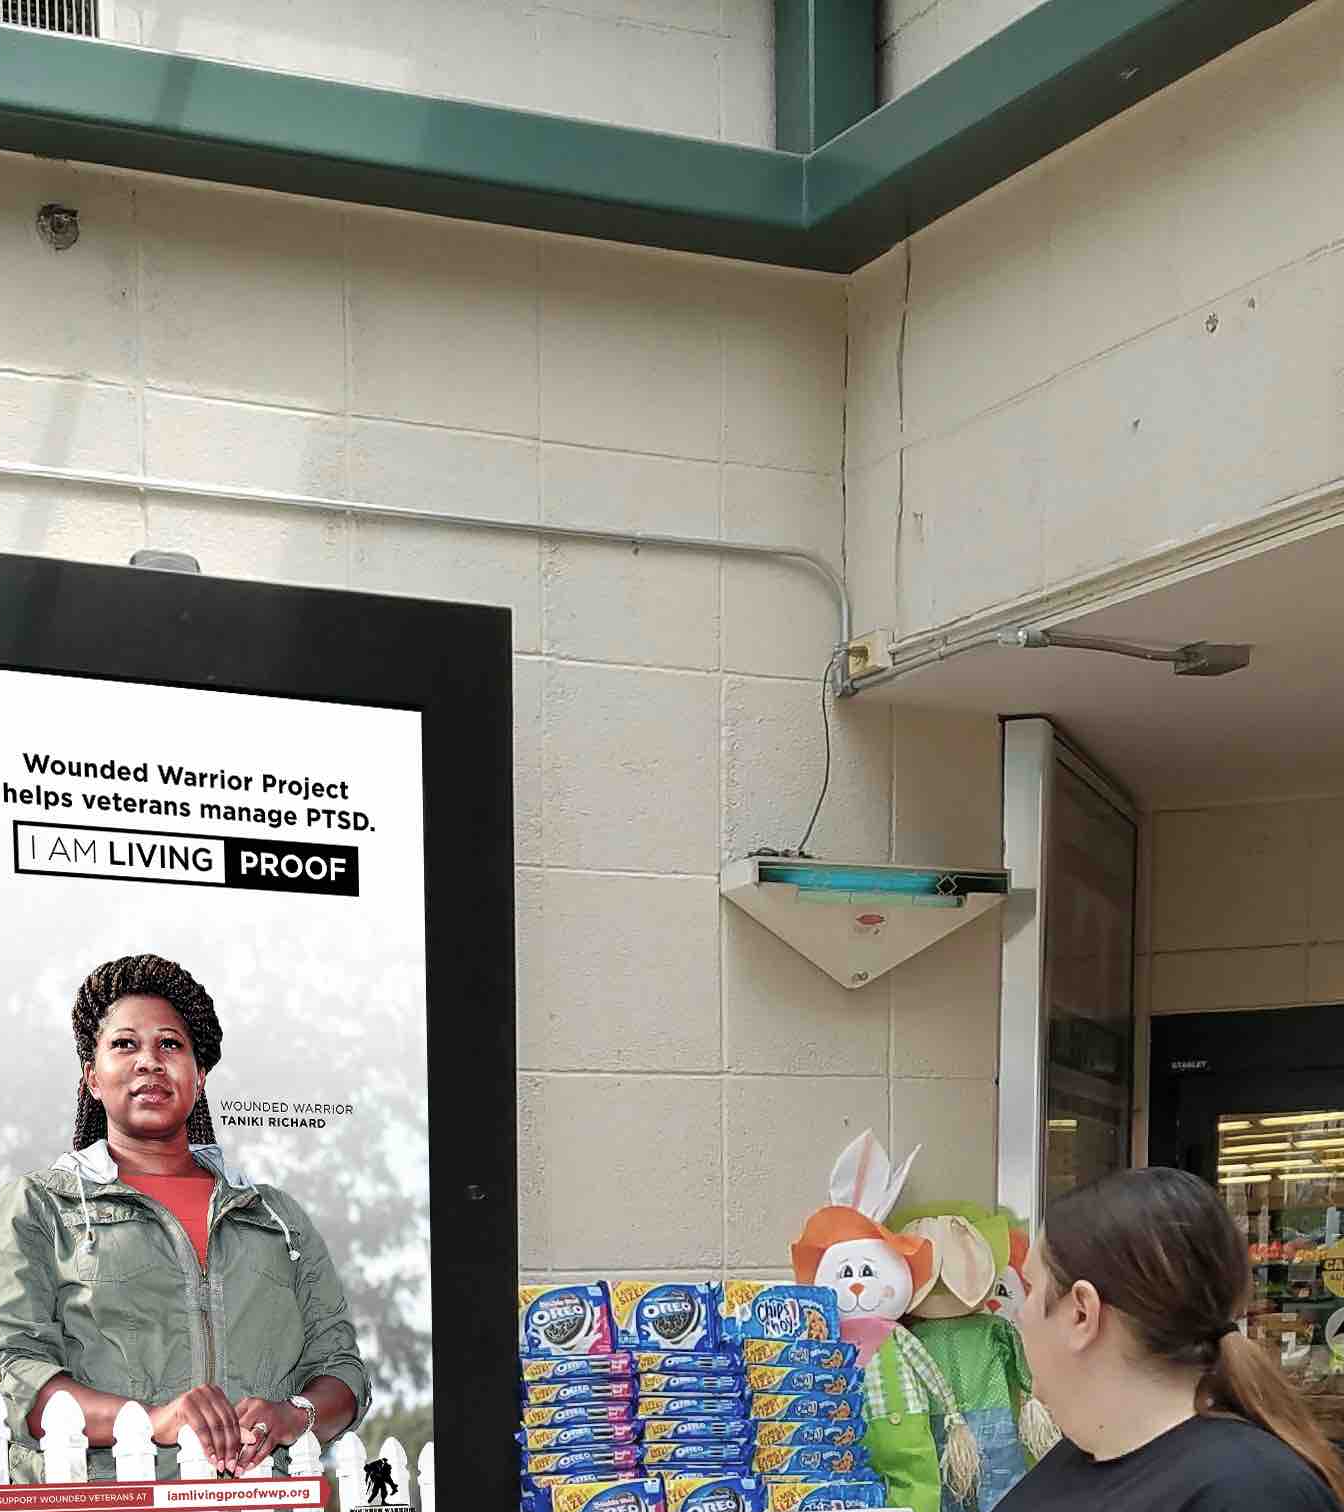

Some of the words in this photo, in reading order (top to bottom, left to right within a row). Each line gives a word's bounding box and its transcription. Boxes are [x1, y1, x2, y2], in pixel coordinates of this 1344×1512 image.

[23, 753, 148, 782] Wounded
[158, 765, 253, 791] Warrior
[262, 773, 349, 800] Project
[3, 783, 73, 809] helps
[83, 793, 191, 817] veterans
[200, 802, 297, 828] manage
[307, 808, 376, 832] PTSD.
[49, 836, 97, 863] AM
[109, 841, 213, 872] LIVING
[240, 850, 347, 881] PROOF
[220, 1100, 288, 1113] WOUNDED
[293, 1103, 353, 1115] WARRIOR
[220, 1116, 263, 1126] TANIKI
[268, 1117, 326, 1128] RICHARD
[531, 1303, 585, 1326] OREO
[642, 1302, 692, 1318] OREO
[40, 1495, 86, 1504] WOUNDED
[89, 1493, 134, 1503] VETERANS
[136, 1493, 147, 1501] AT
[167, 1487, 311, 1503] iamlivingproofwwp.org
